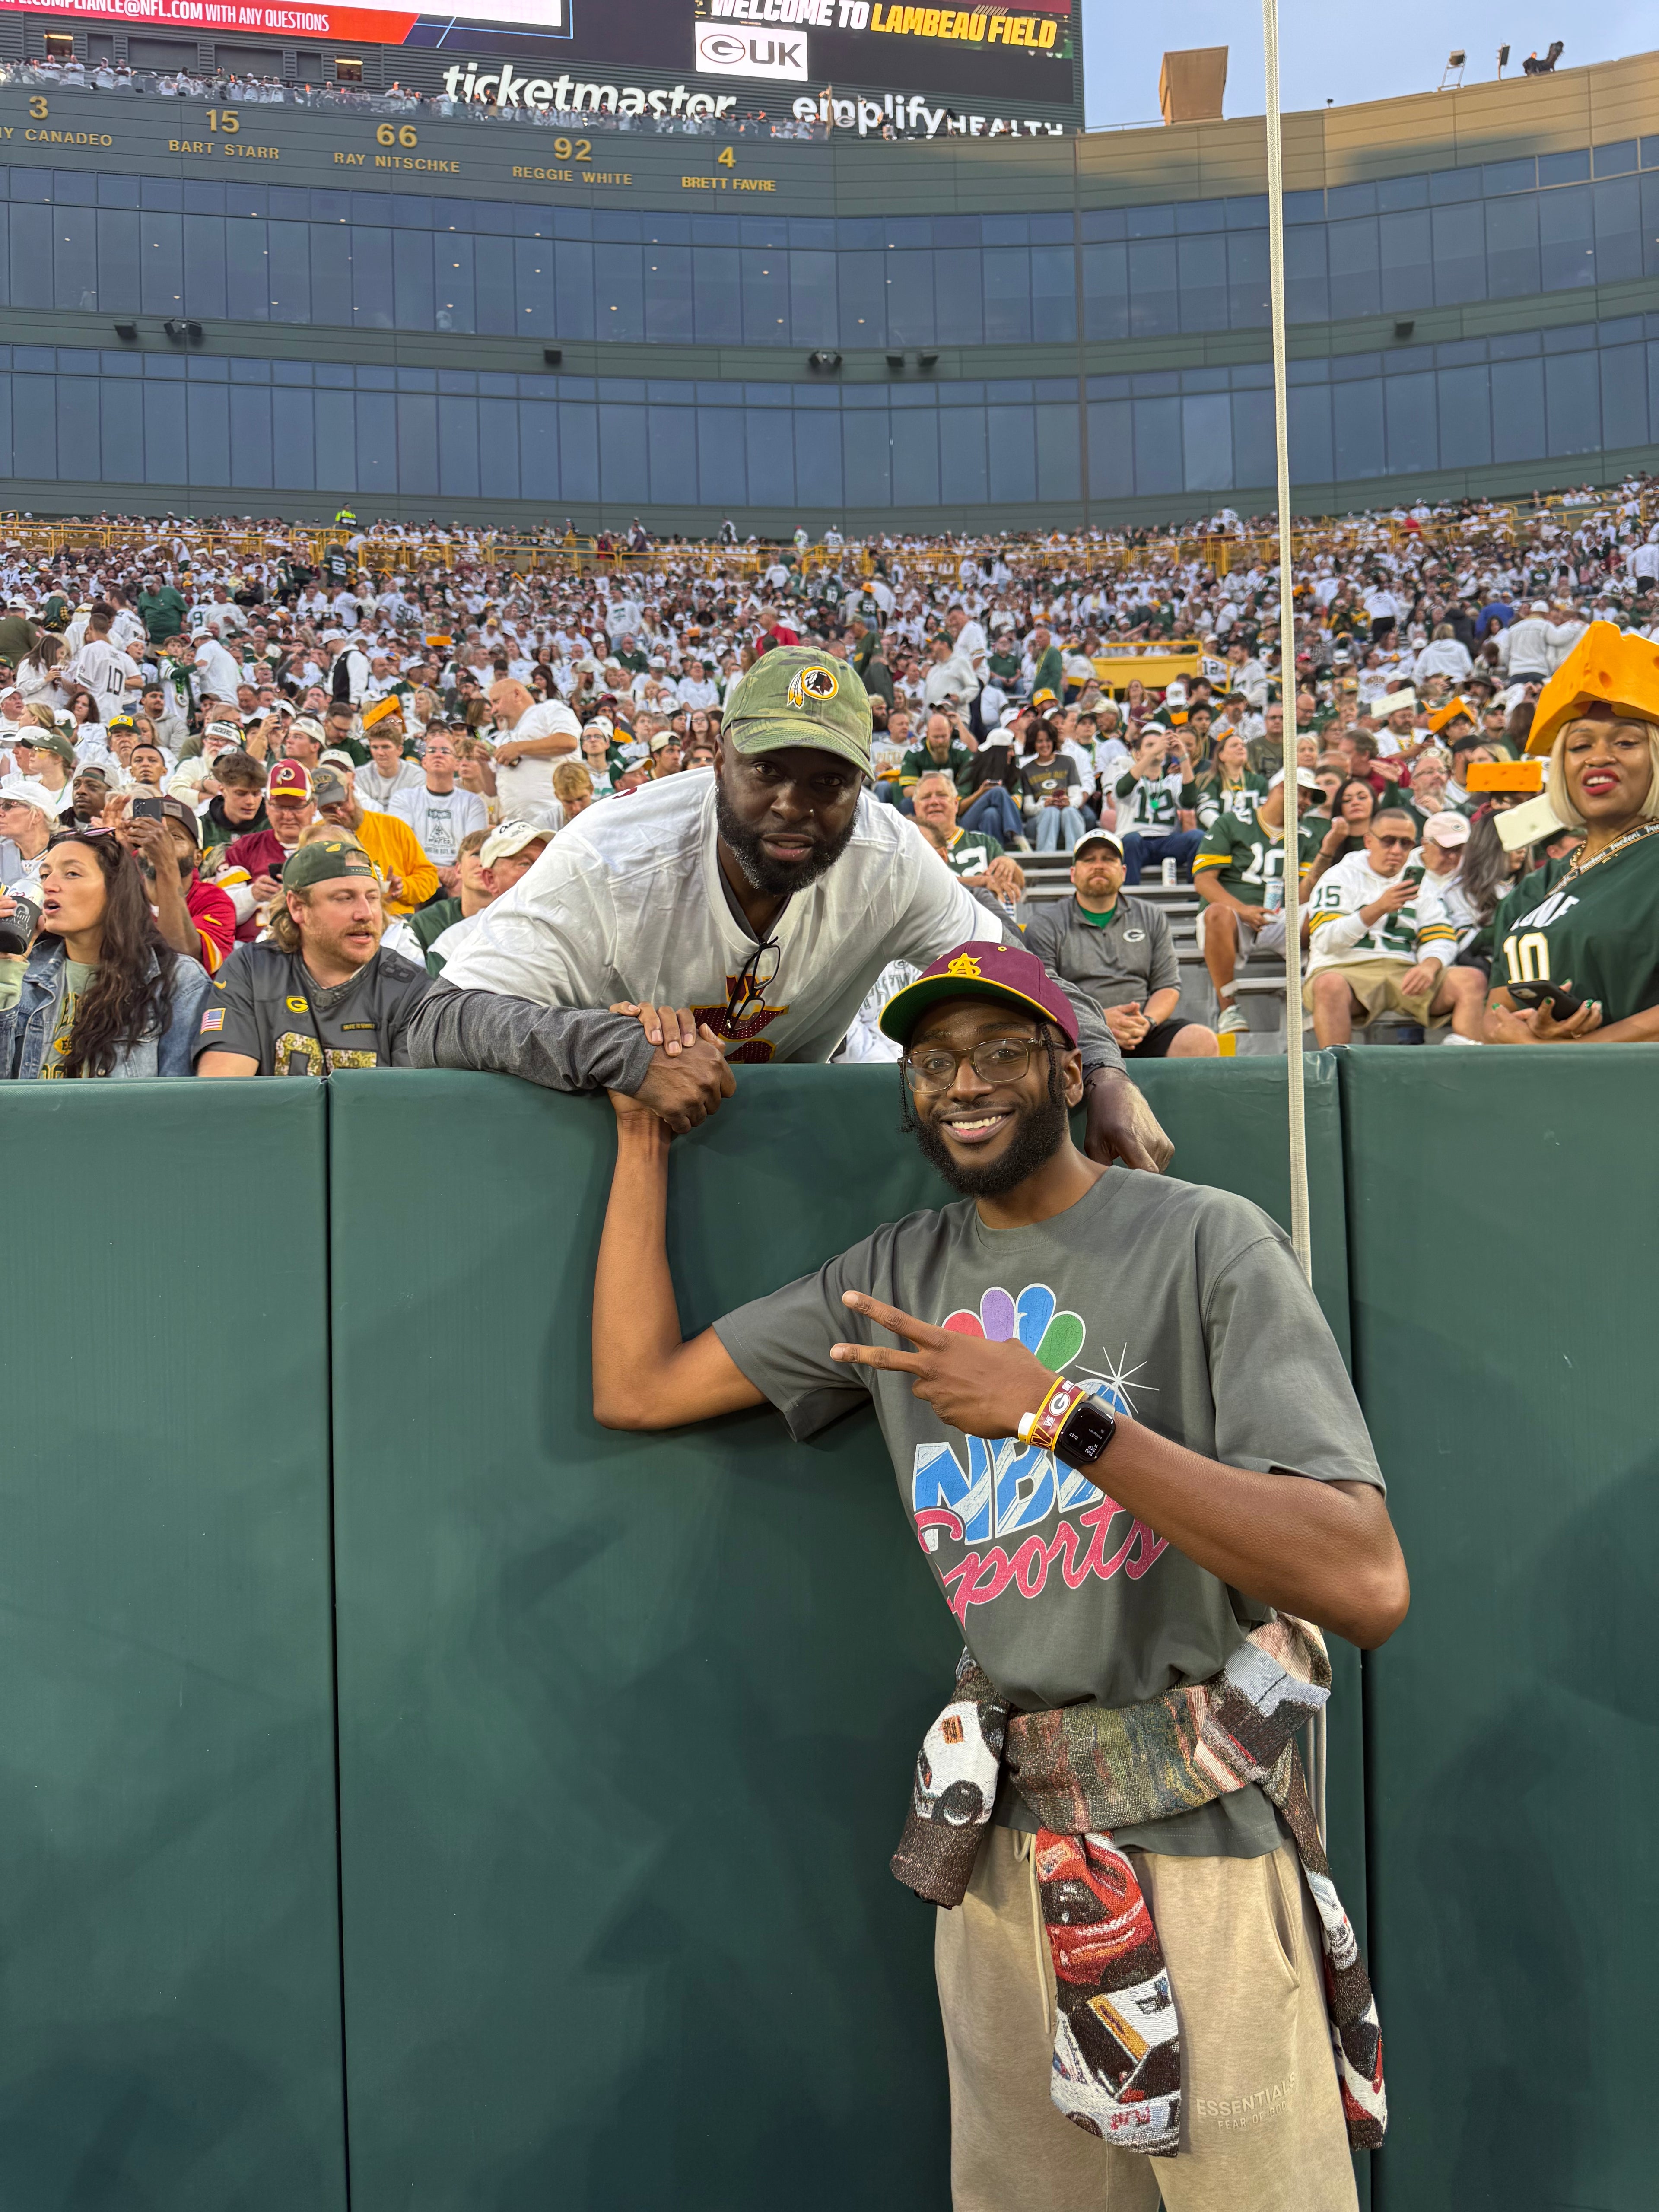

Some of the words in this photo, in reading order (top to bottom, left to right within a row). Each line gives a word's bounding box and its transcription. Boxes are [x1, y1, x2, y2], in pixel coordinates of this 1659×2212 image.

[205, 4, 236, 23] WITH
[238, 7, 262, 25] ANY
[265, 9, 330, 32] QUESTIONS
[711, 0, 835, 26] WELCOME
[839, 0, 870, 30] TO
[870, 3, 987, 41] LAMBEAU
[987, 15, 1057, 48] FIELD
[750, 39, 803, 68] UK
[443, 62, 737, 124] ticketmaster
[29, 95, 48, 120] 3
[206, 109, 240, 134] 15
[0, 127, 14, 139] Y
[25, 129, 112, 146] CANADEO
[376, 123, 418, 148] 66
[169, 140, 215, 154] BART
[224, 144, 279, 159] STARR
[553, 137, 592, 162] 92
[717, 146, 736, 169] 4
[334, 152, 365, 165] RAY
[375, 156, 460, 173] NITSCHKE
[512, 166, 574, 182] REGGIE
[582, 172, 633, 185] WHITE
[682, 176, 729, 190] BRETT
[733, 178, 777, 191] FAVRE
[1133, 785, 1176, 826] 12
[947, 845, 988, 877] 2
[1313, 885, 1341, 908] 15
[1503, 931, 1550, 985] 10
[1196, 2071, 1295, 2117] ESSENTIALS
[1217, 2117, 1246, 2129] FEAR
[1252, 2111, 1263, 2124] OF
[1269, 2100, 1287, 2117] GOD
